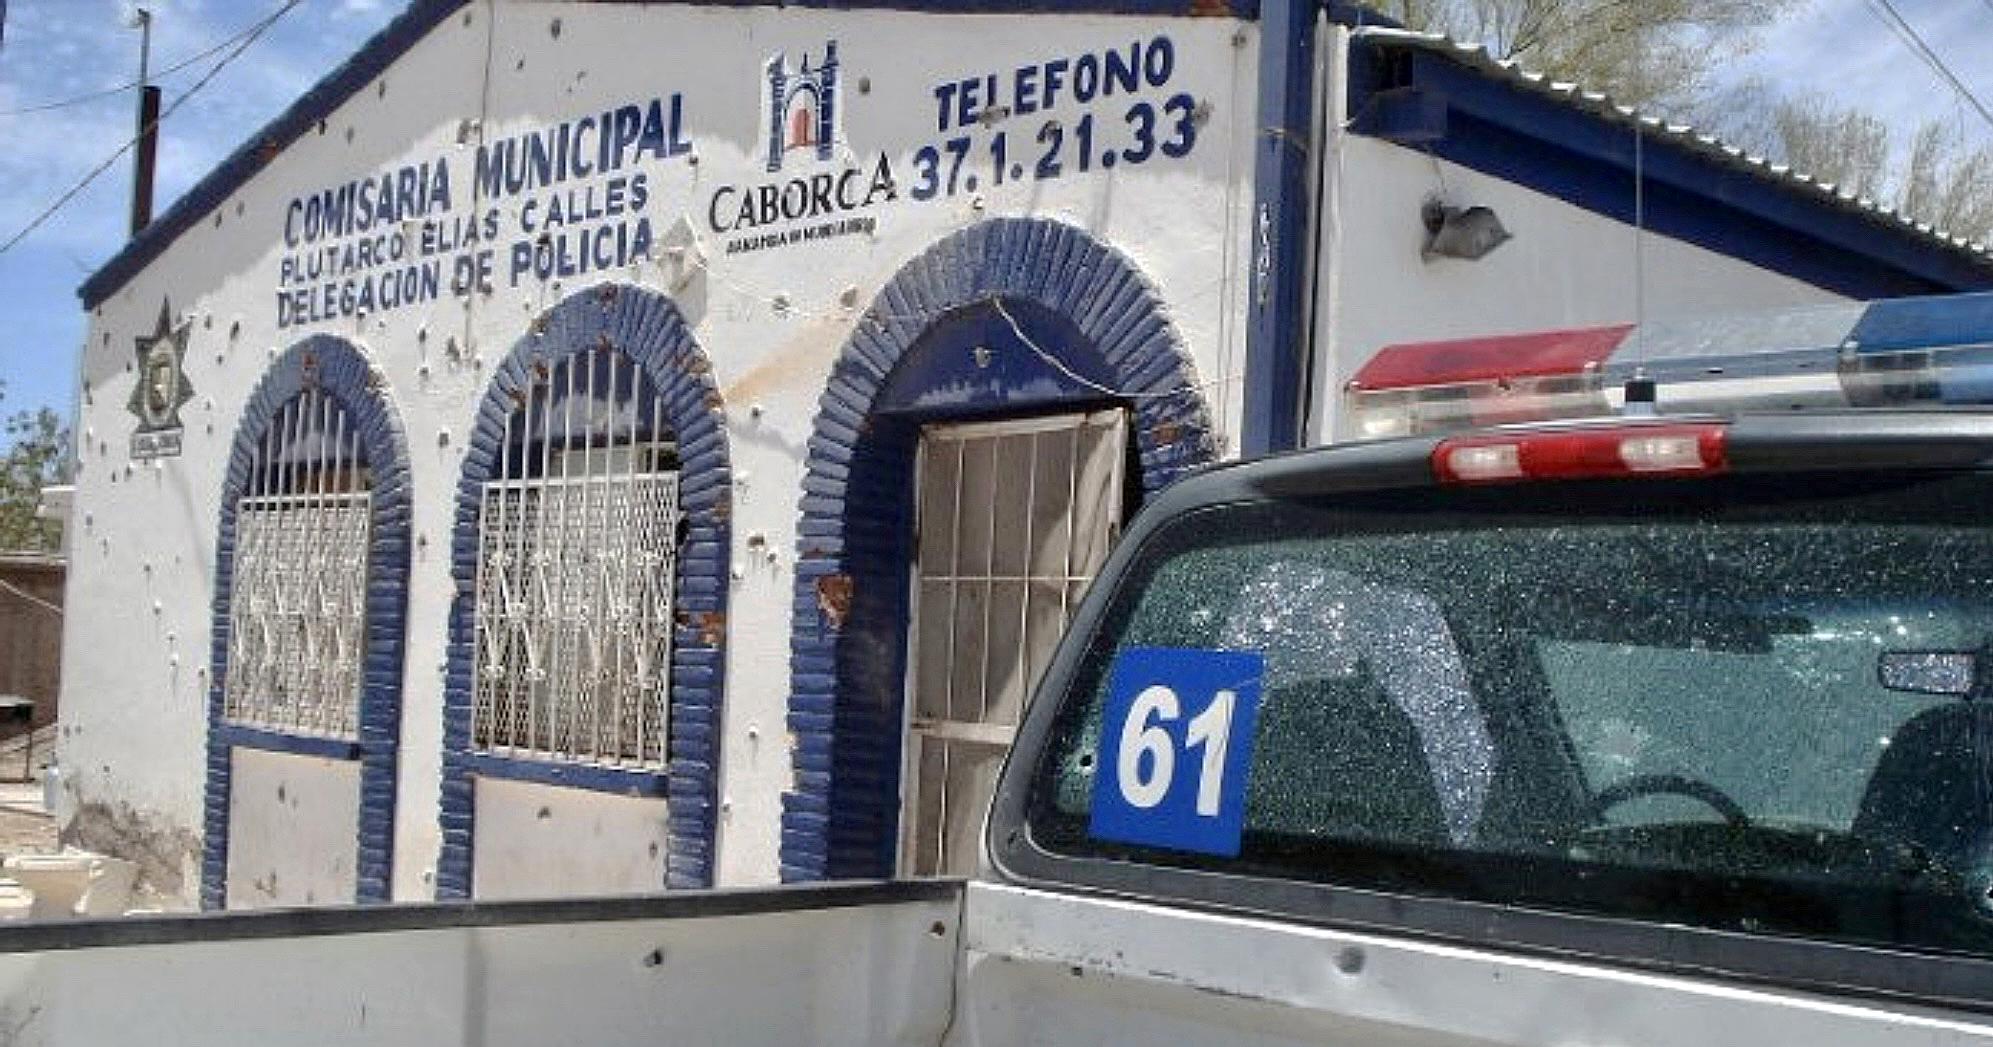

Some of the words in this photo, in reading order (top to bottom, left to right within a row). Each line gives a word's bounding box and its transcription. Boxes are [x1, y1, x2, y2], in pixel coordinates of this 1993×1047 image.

[934, 36, 1174, 133] TELEFONO
[285, 157, 450, 248] COMISARIA
[477, 91, 693, 198] MUNICIPAL
[709, 150, 897, 233] CABORCA
[277, 260, 440, 328] DELEGACION
[451, 250, 494, 296] DE
[511, 217, 653, 287] POLICIA
[281, 231, 404, 287] PLUTARCO
[421, 208, 499, 256] ELIAS
[521, 173, 648, 232] CALLES
[1118, 684, 1236, 817] 61
